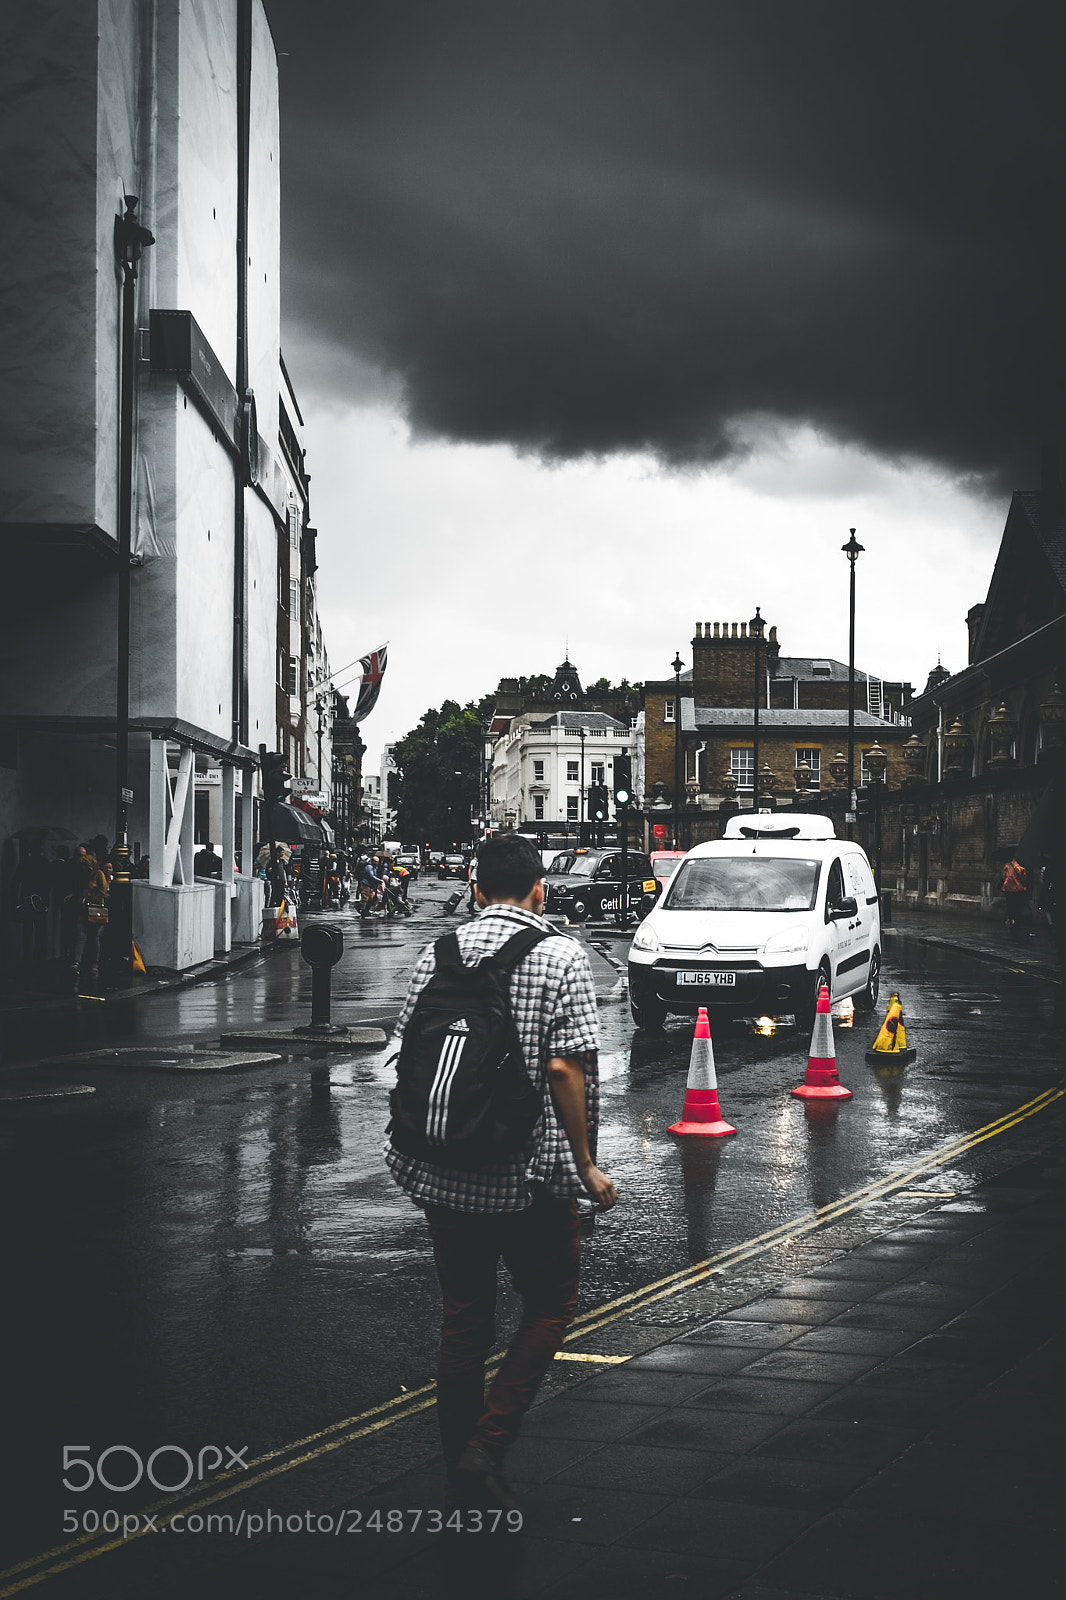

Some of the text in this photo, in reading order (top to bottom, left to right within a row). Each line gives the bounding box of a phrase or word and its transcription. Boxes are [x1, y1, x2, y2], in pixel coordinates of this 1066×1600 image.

[600, 898, 618, 910] Gett
[683, 973, 734, 984] LJ65 YHB
